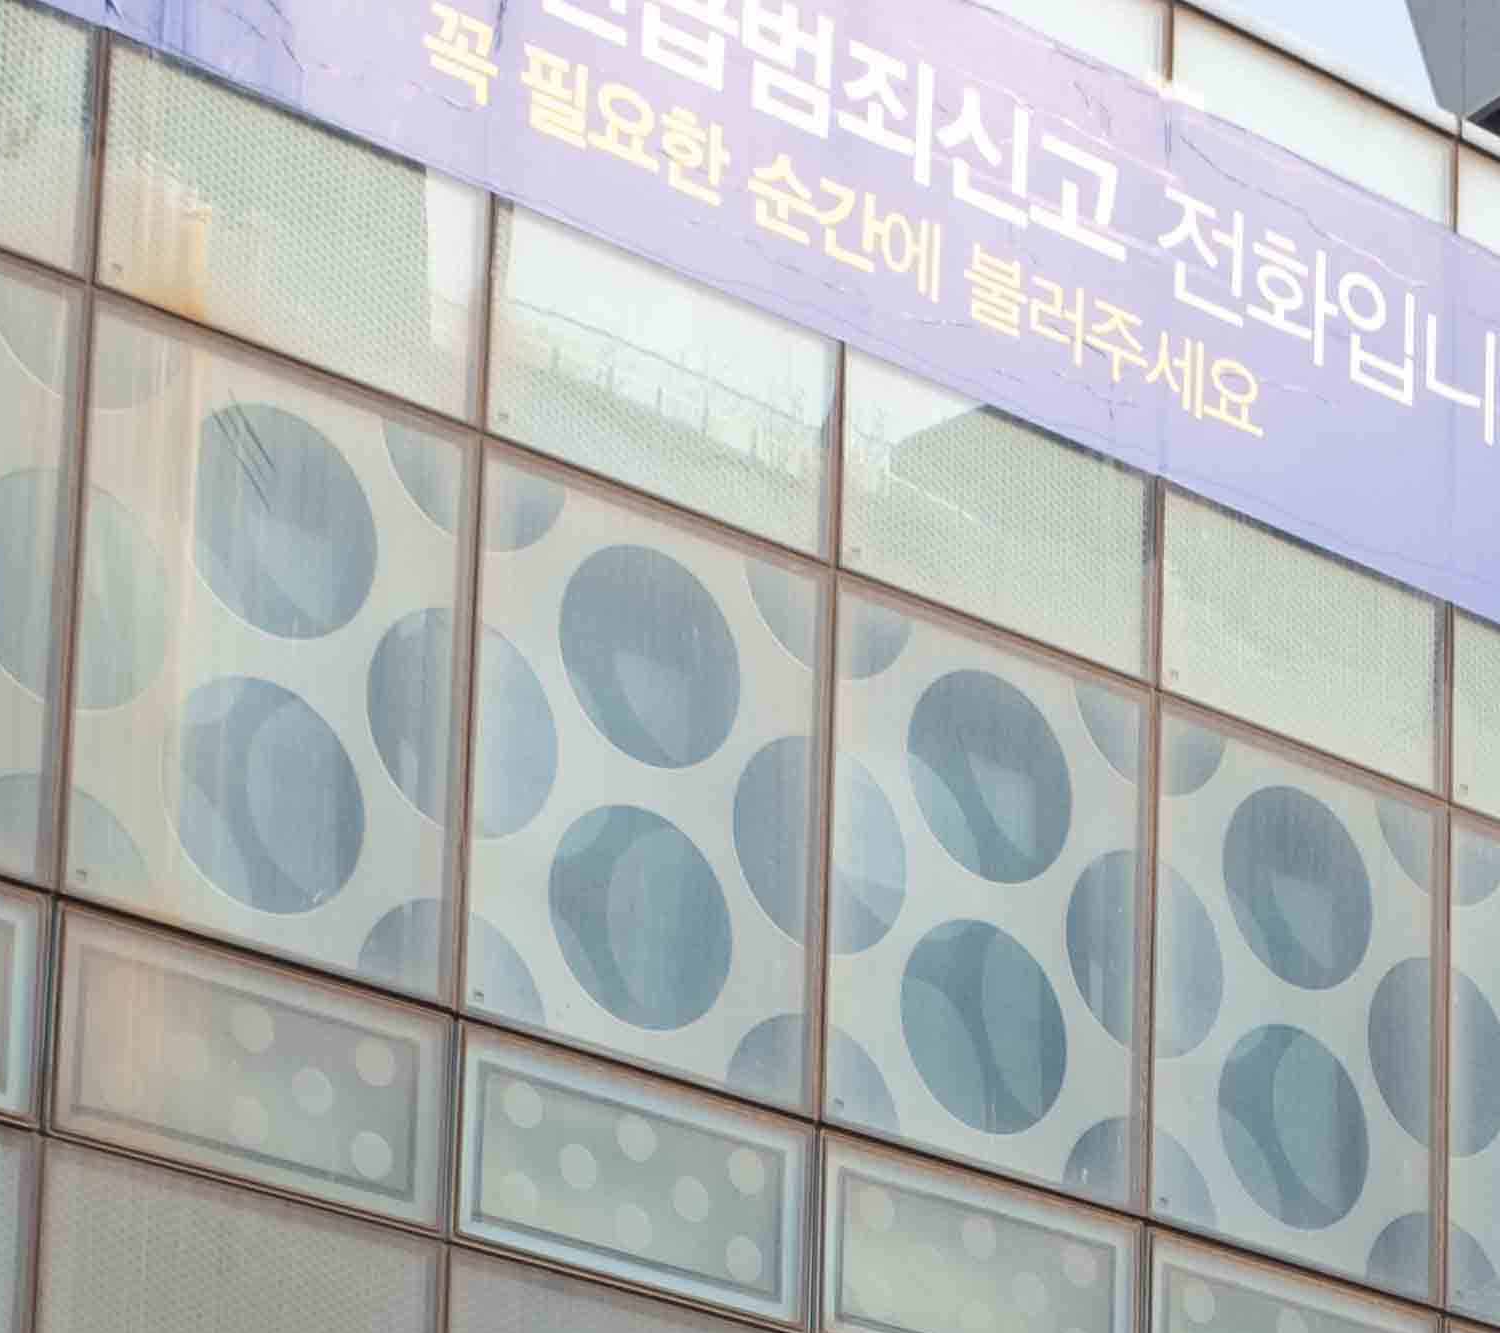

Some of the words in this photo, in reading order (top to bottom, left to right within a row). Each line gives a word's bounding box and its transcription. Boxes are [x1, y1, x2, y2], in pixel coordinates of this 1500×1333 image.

[422, 6, 499, 108] 꼭
[520, 41, 731, 207] 필요한
[747, 153, 943, 303] 순간에
[963, 243, 1264, 438] 불러주세요
